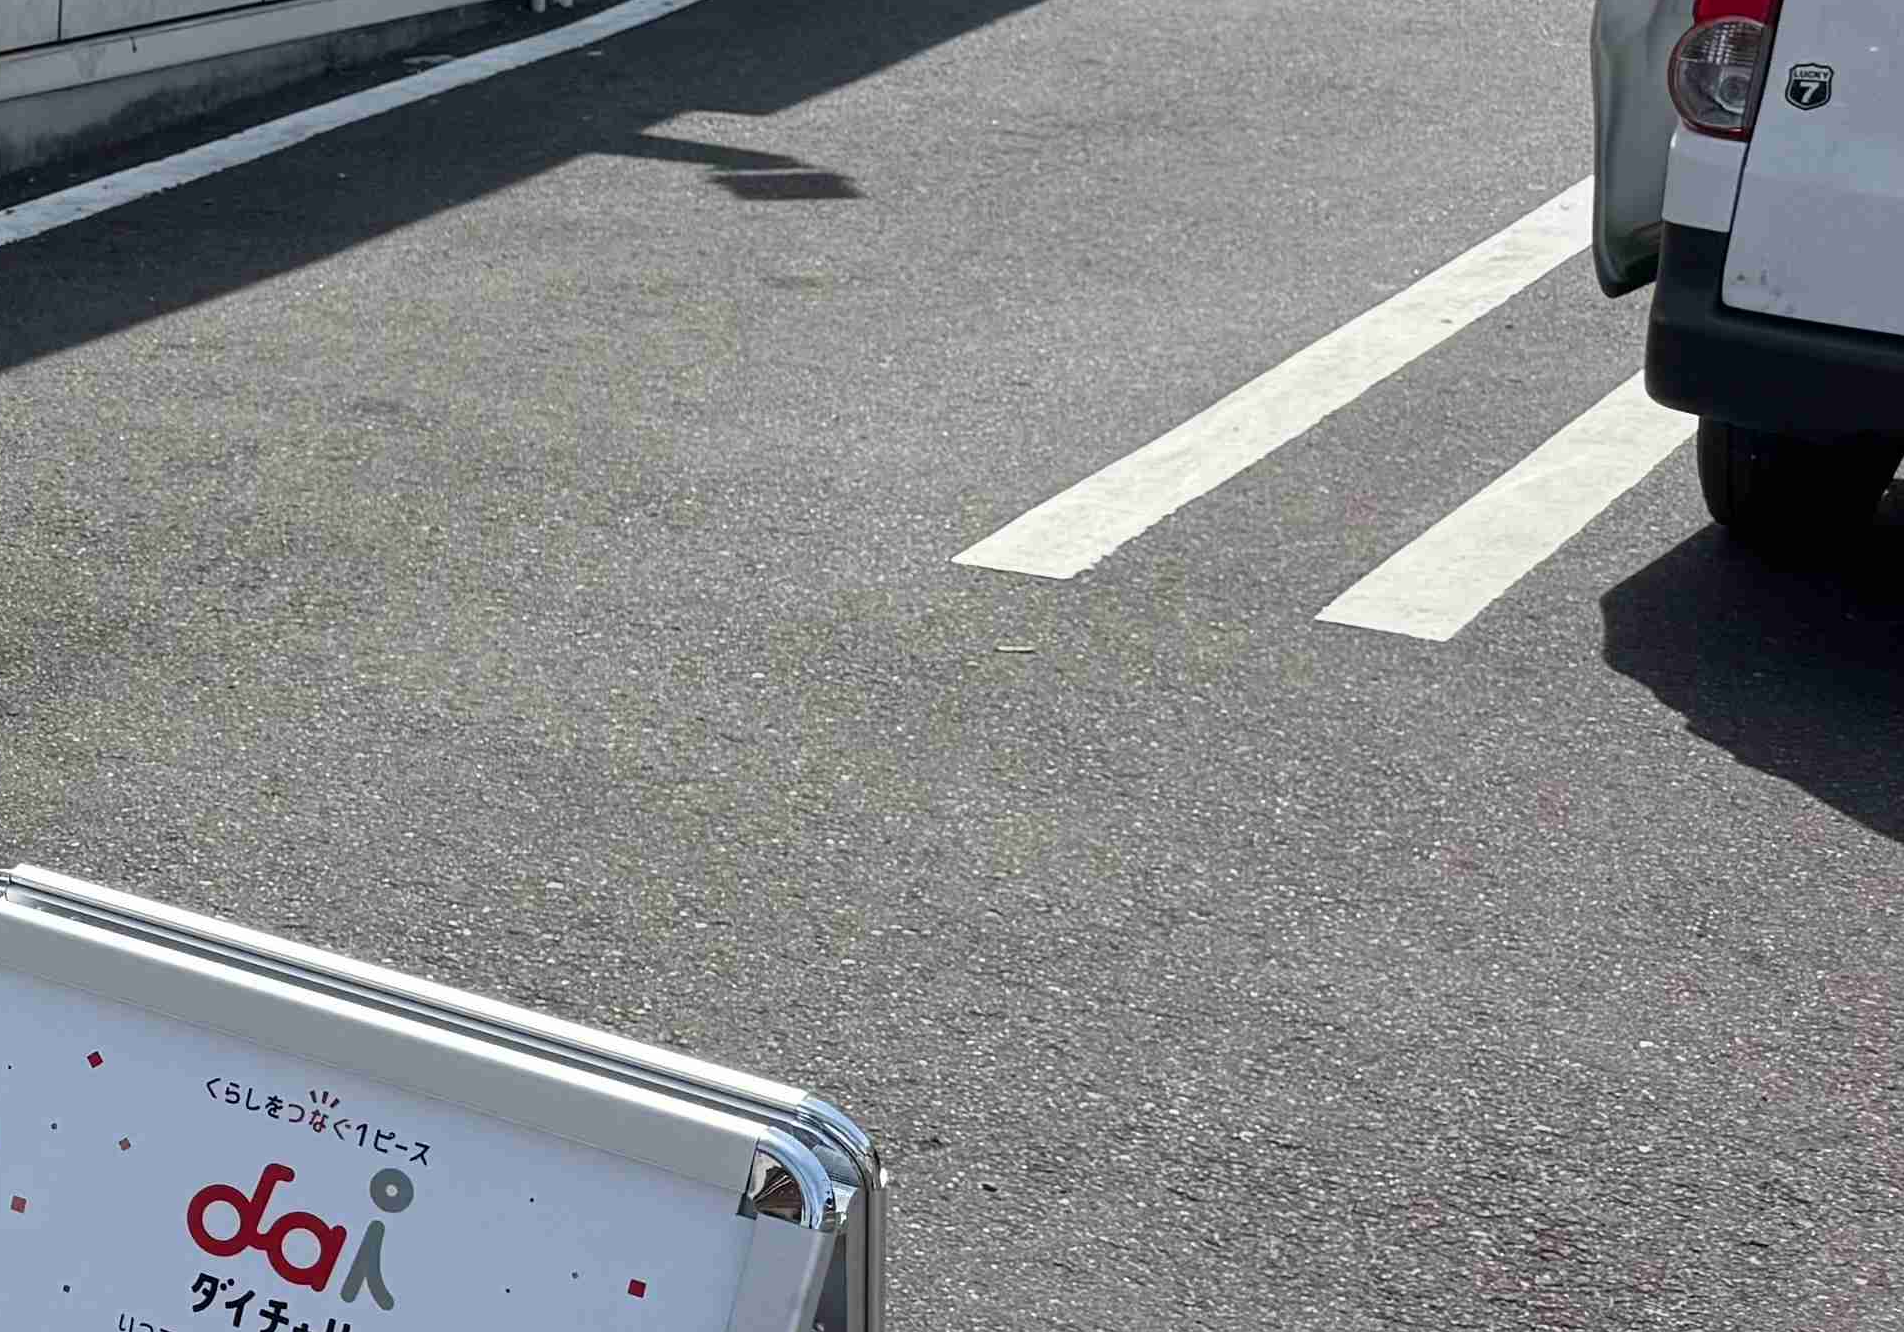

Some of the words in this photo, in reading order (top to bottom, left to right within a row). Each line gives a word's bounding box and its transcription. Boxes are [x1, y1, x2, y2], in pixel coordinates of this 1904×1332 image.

[1800, 81, 1820, 104] 7
[205, 1077, 431, 1166] くらしをつなぐ1ピース
[187, 1163, 415, 1311] dai
